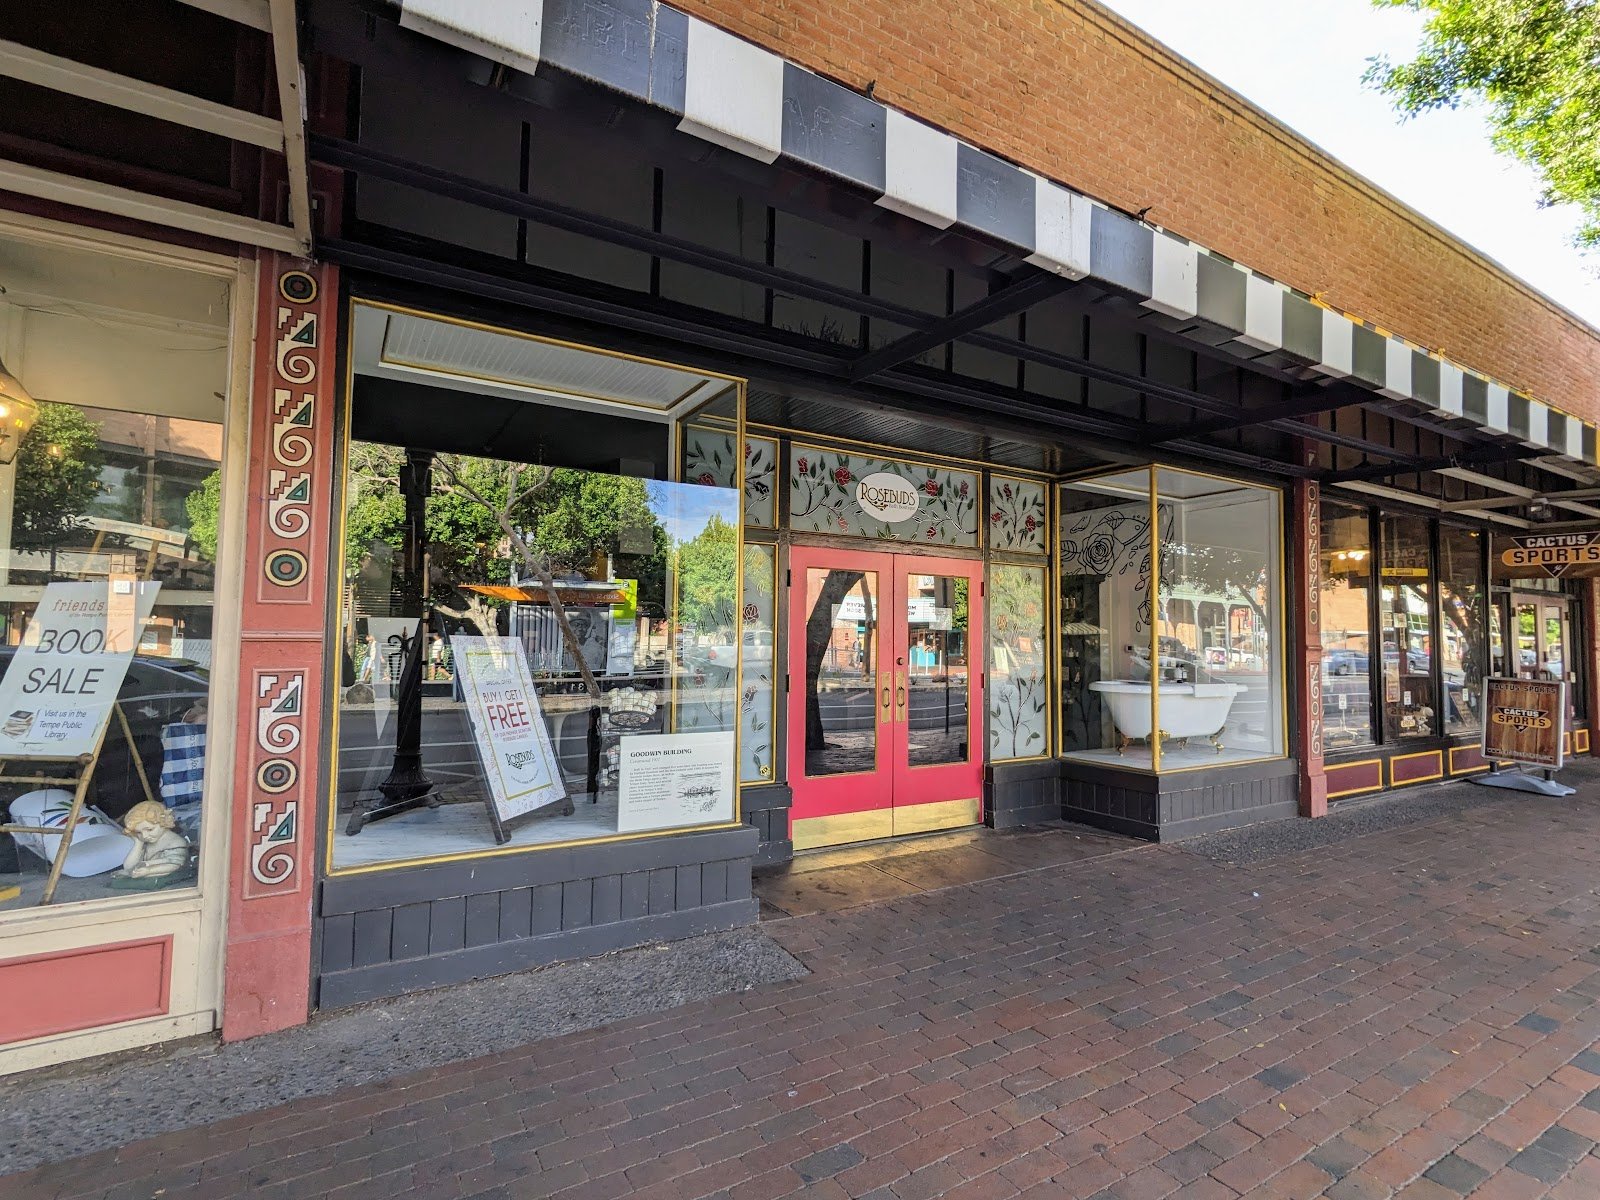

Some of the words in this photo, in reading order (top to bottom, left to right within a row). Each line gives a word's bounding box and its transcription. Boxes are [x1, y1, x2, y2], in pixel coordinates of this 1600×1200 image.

[1526, 534, 1588, 548] CACTUS
[1513, 546, 1600, 564] SPORTS
[52, 599, 106, 613] friends
[35, 629, 127, 655] BOOK
[22, 667, 105, 695] SALE
[1523, 685, 1557, 694] SPORTS
[482, 691, 497, 703] BUY
[505, 690, 518, 701] GET
[44, 709, 58, 718] Visit
[75, 709, 87, 718] the
[486, 702, 530, 731] FREE
[1503, 708, 1540, 718] CACTUS
[39, 720, 61, 730] Tempe
[61, 720, 83, 729] Public
[1498, 715, 1547, 727] SPORTS
[44, 731, 68, 741] Library
[630, 749, 662, 758] GOODWIN
[663, 747, 692, 756] BUILDING
